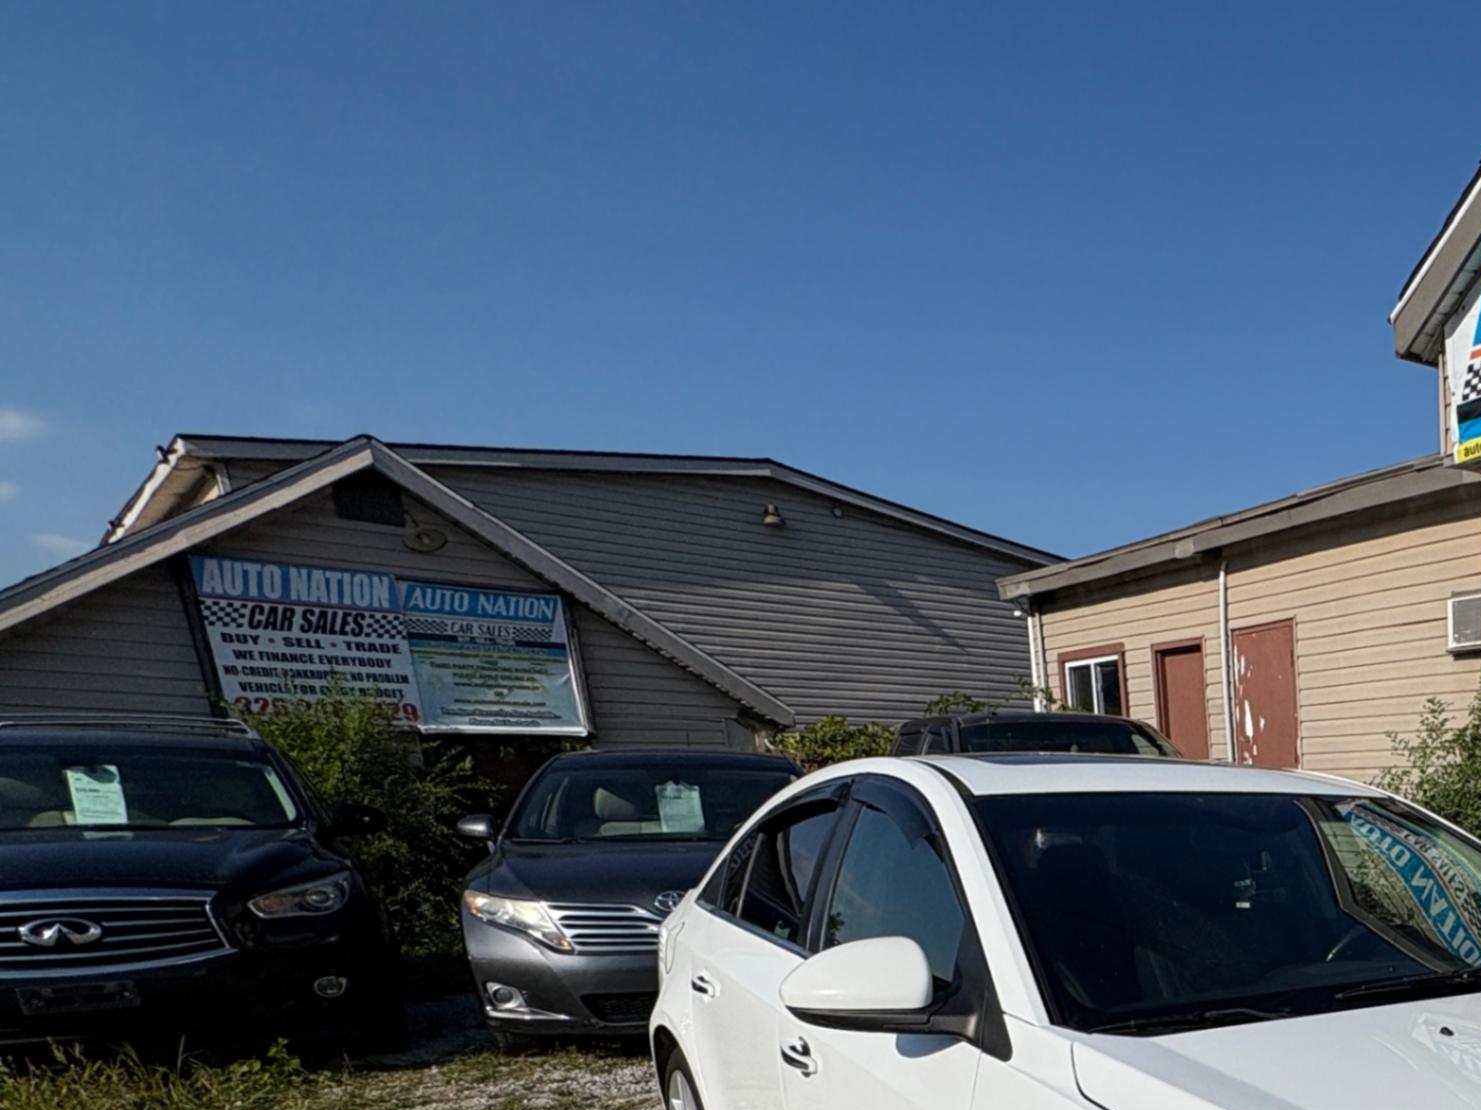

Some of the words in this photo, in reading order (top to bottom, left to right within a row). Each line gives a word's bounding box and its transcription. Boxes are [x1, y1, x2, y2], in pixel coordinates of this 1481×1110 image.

[202, 558, 283, 600] AUTO
[289, 566, 391, 608] NATION
[408, 586, 470, 613] AUTO
[476, 594, 554, 621] NATION
[248, 604, 296, 632] CAR
[300, 608, 367, 637] SALES
[450, 621, 474, 635] CAR
[477, 625, 513, 638] SALES
[220, 632, 261, 646] BUY
[281, 636, 326, 650] SELL
[343, 640, 403, 655] TRADE
[232, 649, 256, 661] WE
[258, 650, 318, 665] FINANCE
[319, 654, 392, 669] EVERYBODY
